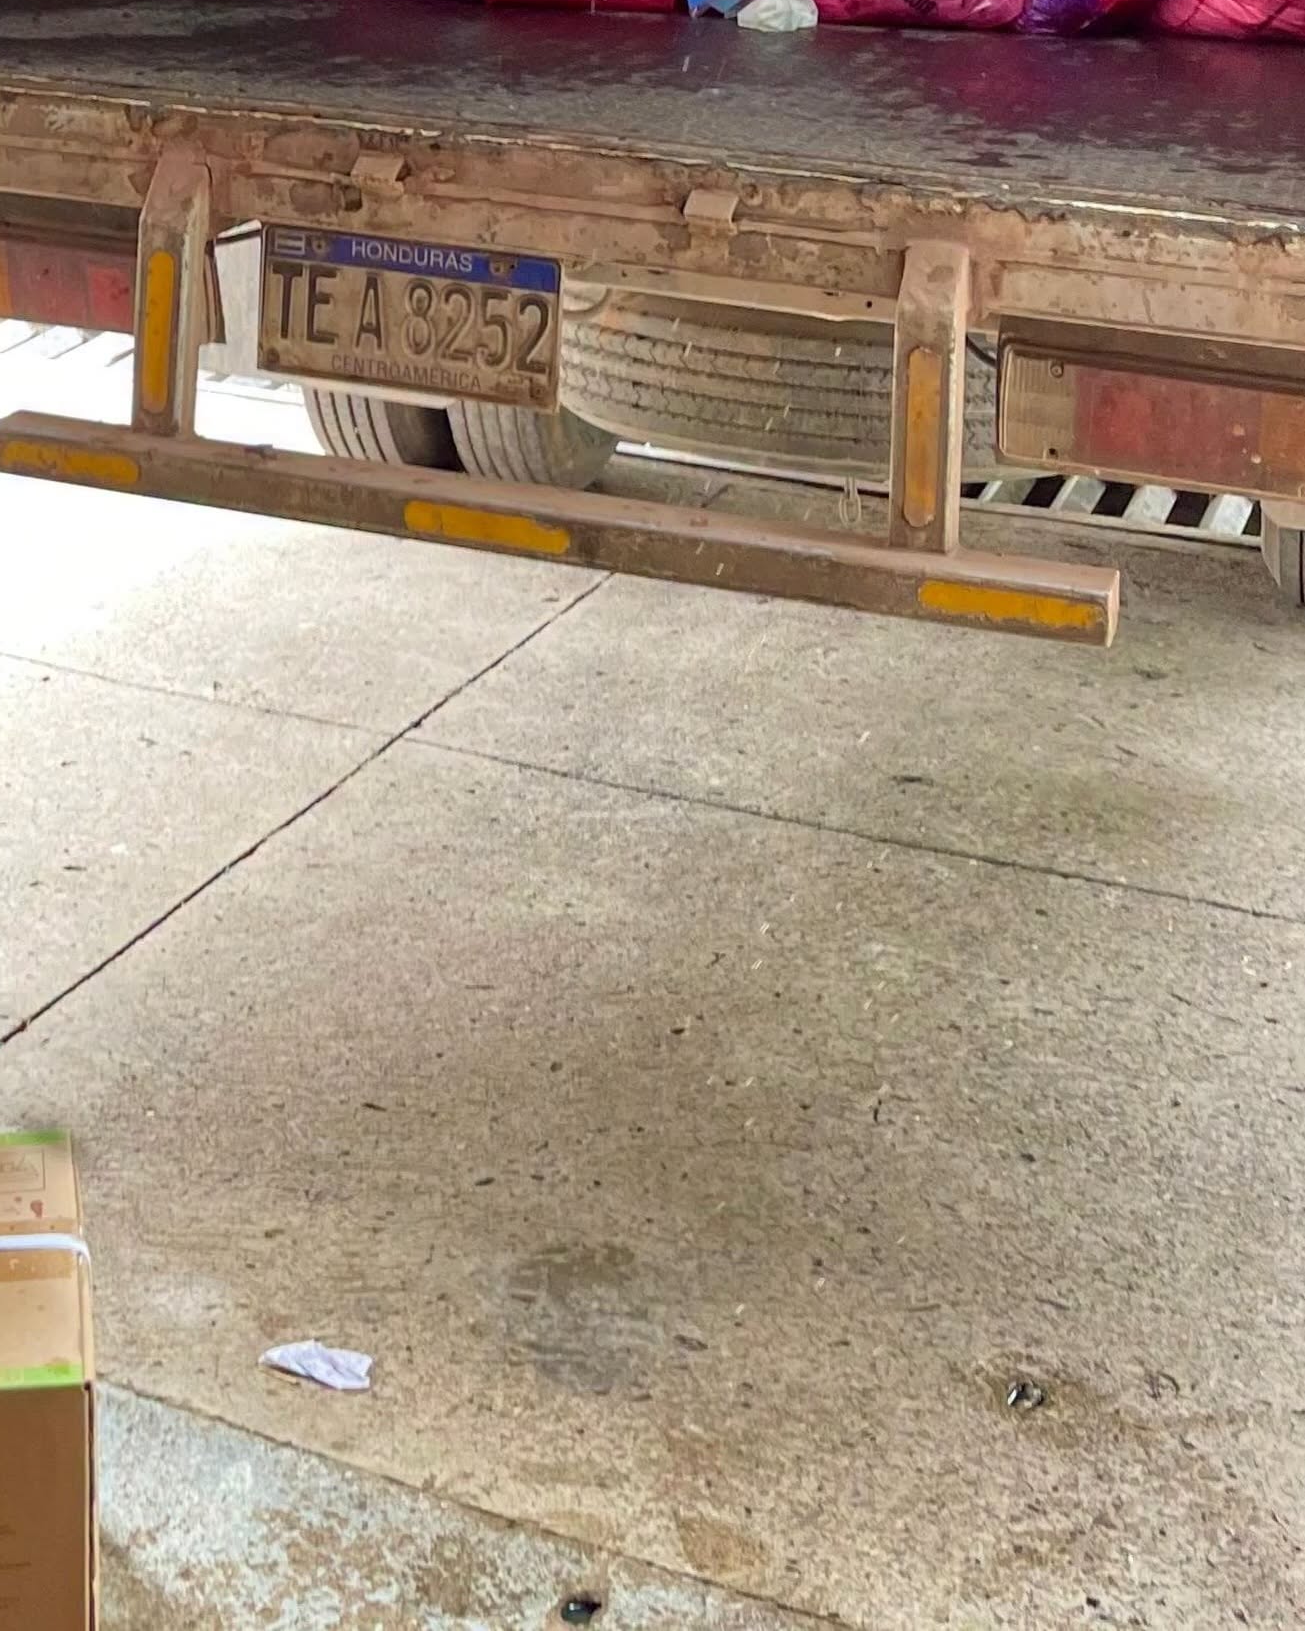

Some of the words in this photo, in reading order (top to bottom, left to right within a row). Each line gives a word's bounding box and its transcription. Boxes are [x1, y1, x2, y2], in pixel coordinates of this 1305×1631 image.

[351, 240, 473, 273] HONDURAS
[404, 277, 550, 375] 8252
[331, 354, 482, 391] CENTROAMERICA
